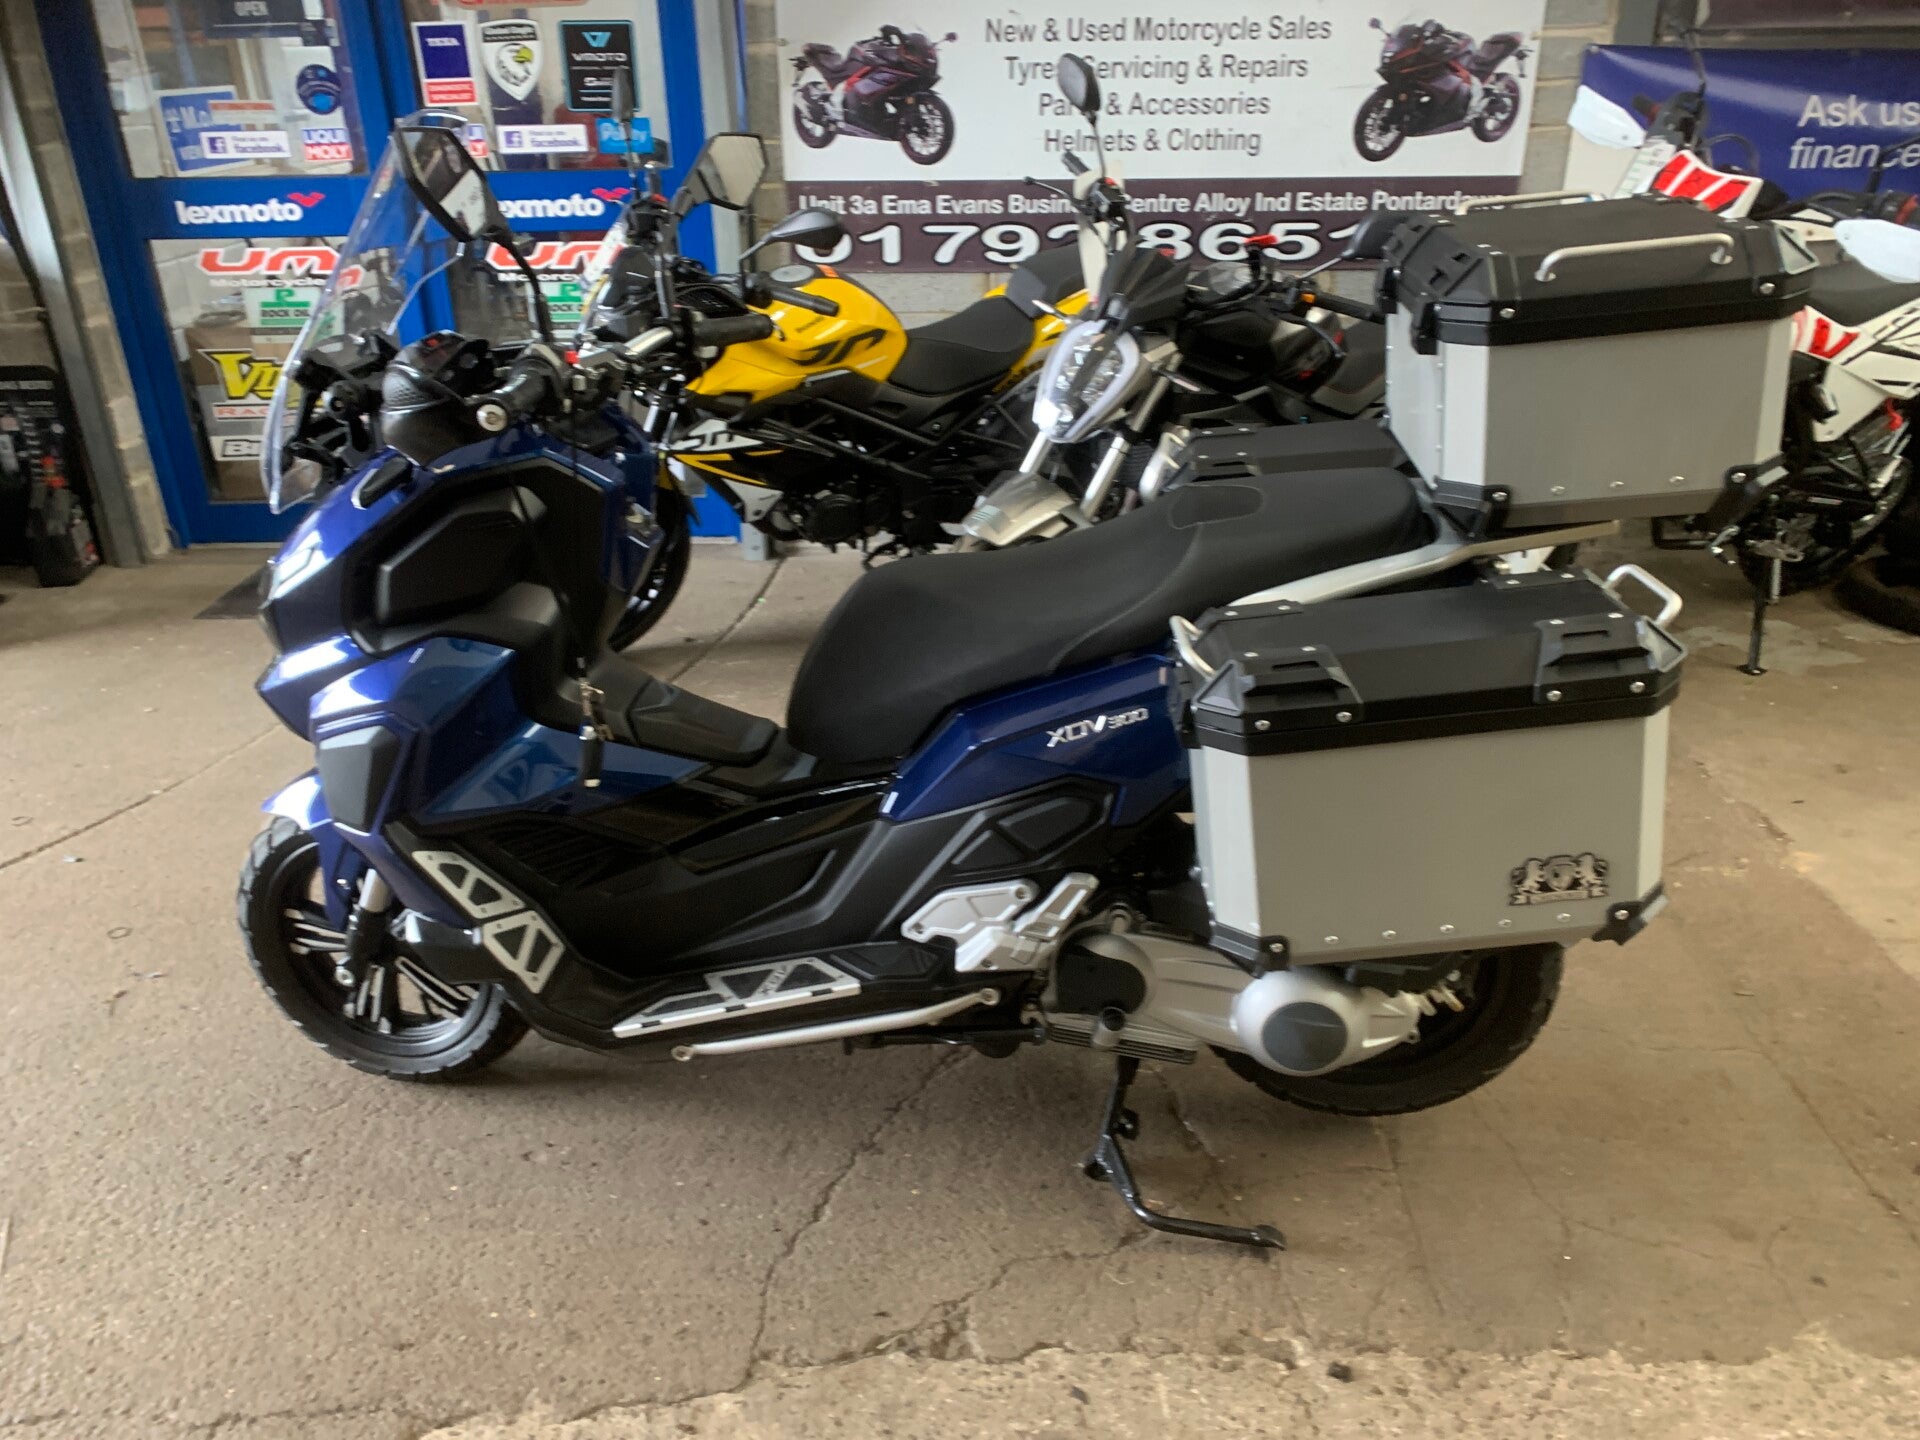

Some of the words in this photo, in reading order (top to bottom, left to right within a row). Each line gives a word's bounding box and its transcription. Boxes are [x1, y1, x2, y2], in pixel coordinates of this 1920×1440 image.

[985, 18, 1036, 42] New
[1043, 18, 1060, 41] &
[1067, 17, 1126, 41] Used
[1133, 15, 1261, 46] Motorcycle
[1267, 15, 1332, 40] Sales
[1004, 56, 1060, 85] Tyre
[1198, 55, 1213, 77] &
[1219, 53, 1309, 82] Repairs
[1105, 92, 1122, 115] &
[1128, 91, 1271, 115] Accessories
[1797, 94, 1869, 128] Ask
[1880, 101, 1920, 127] us
[306, 144, 350, 159] MOLY
[1044, 128, 1136, 152] Helmets
[1144, 129, 1161, 151] &
[1167, 127, 1262, 156] Clothing
[174, 198, 303, 225] lexmoto
[497, 193, 605, 218] exmoto
[849, 195, 878, 215] 3a
[882, 194, 932, 214] Ema
[936, 194, 1003, 214] Evans
[1008, 193, 1080, 213] Busin
[1195, 192, 1250, 217] Alloy
[1255, 192, 1294, 212] Ind
[1296, 191, 1366, 212] Estate
[209, 278, 327, 289] Motorcycle
[261, 309, 289, 317] ROCK
